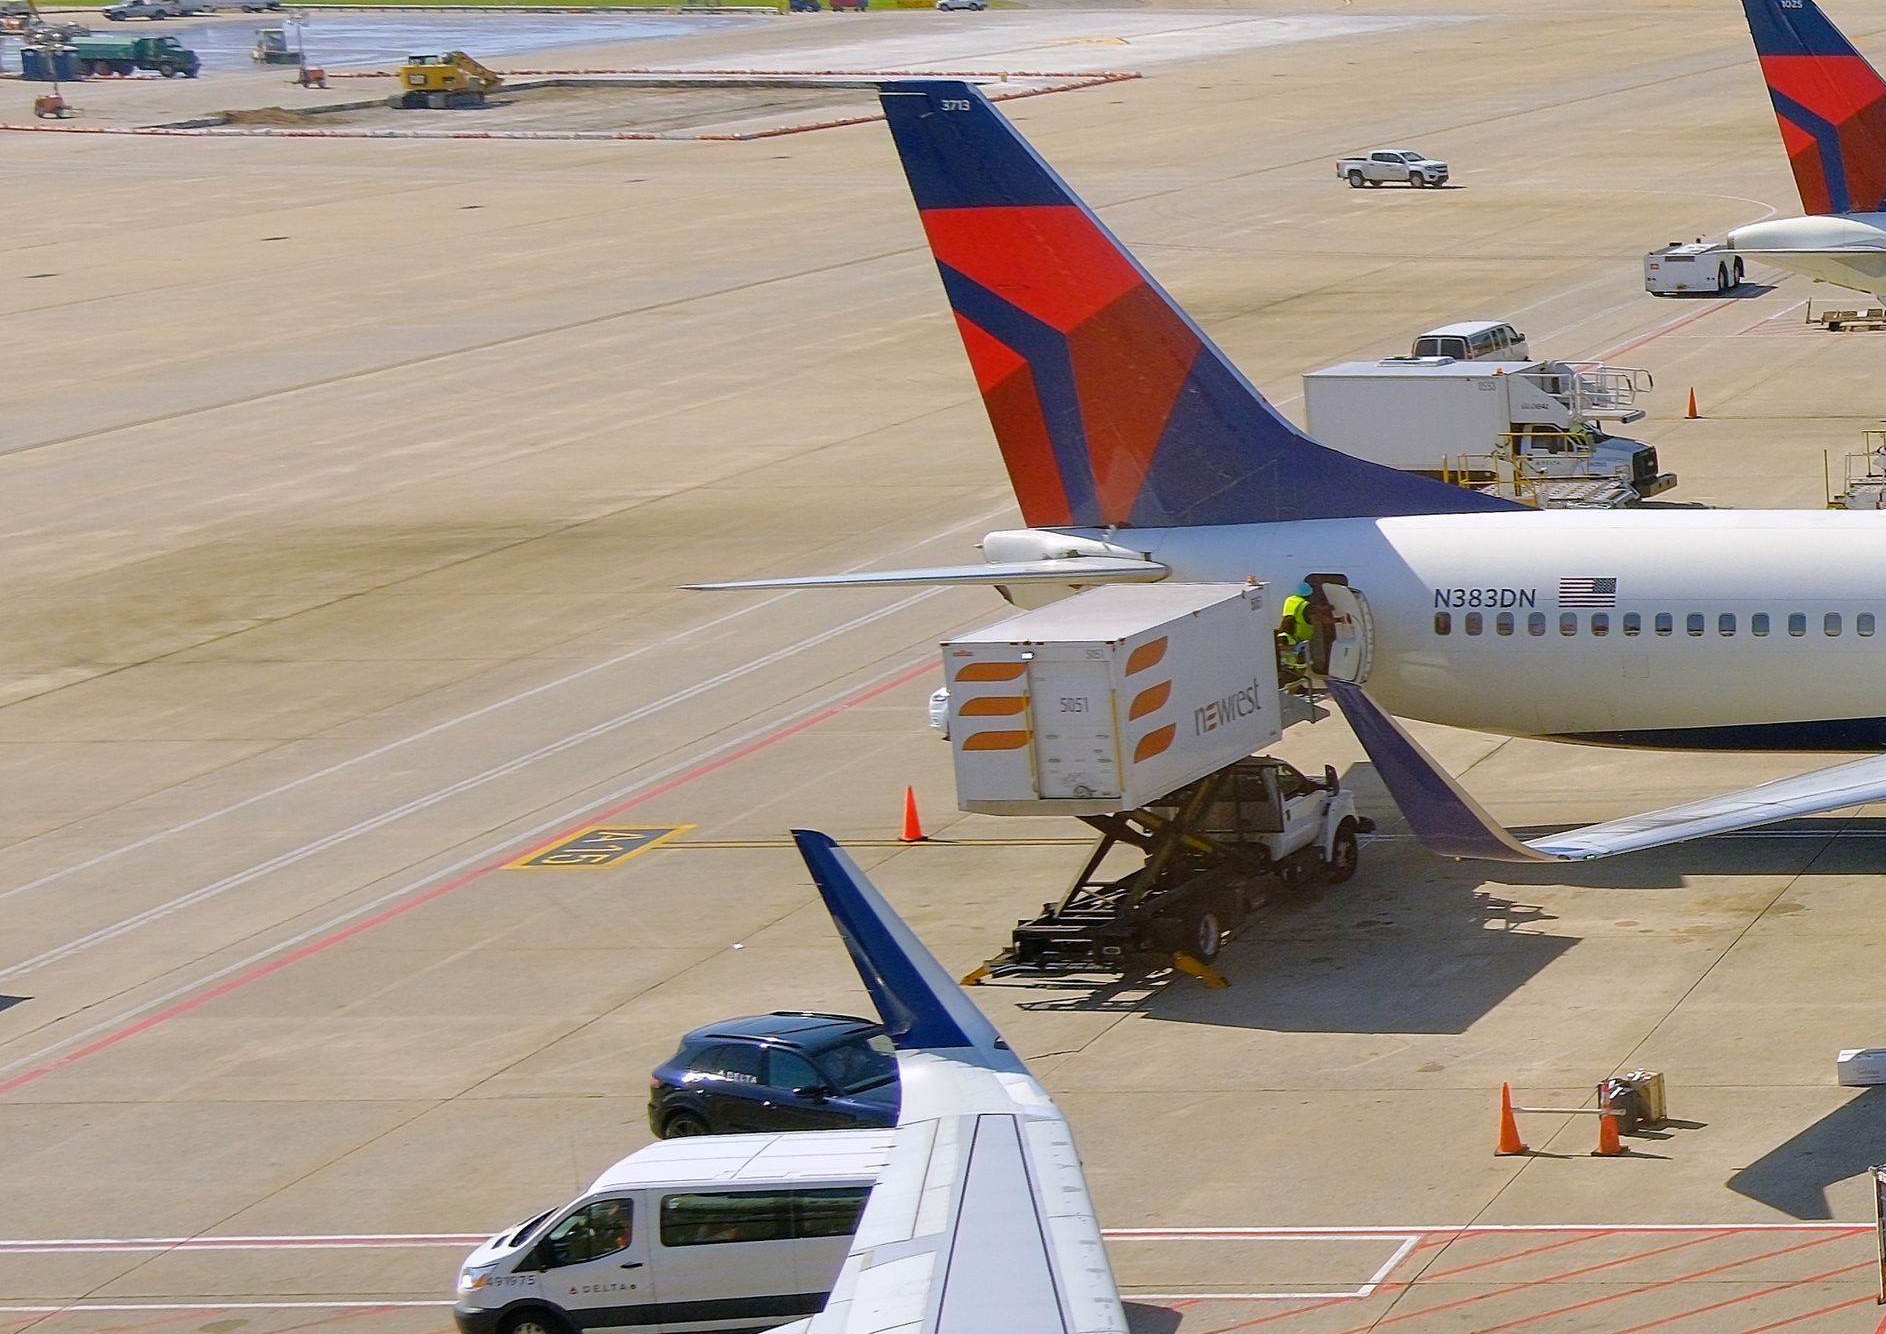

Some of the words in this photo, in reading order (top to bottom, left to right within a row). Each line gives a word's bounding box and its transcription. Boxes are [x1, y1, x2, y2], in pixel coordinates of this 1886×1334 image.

[1435, 588, 1536, 608] N383DN
[1060, 697, 1088, 713] 5051
[541, 830, 647, 865] A15
[486, 1274, 536, 1287] 491975
[583, 1283, 630, 1294] DELTA
